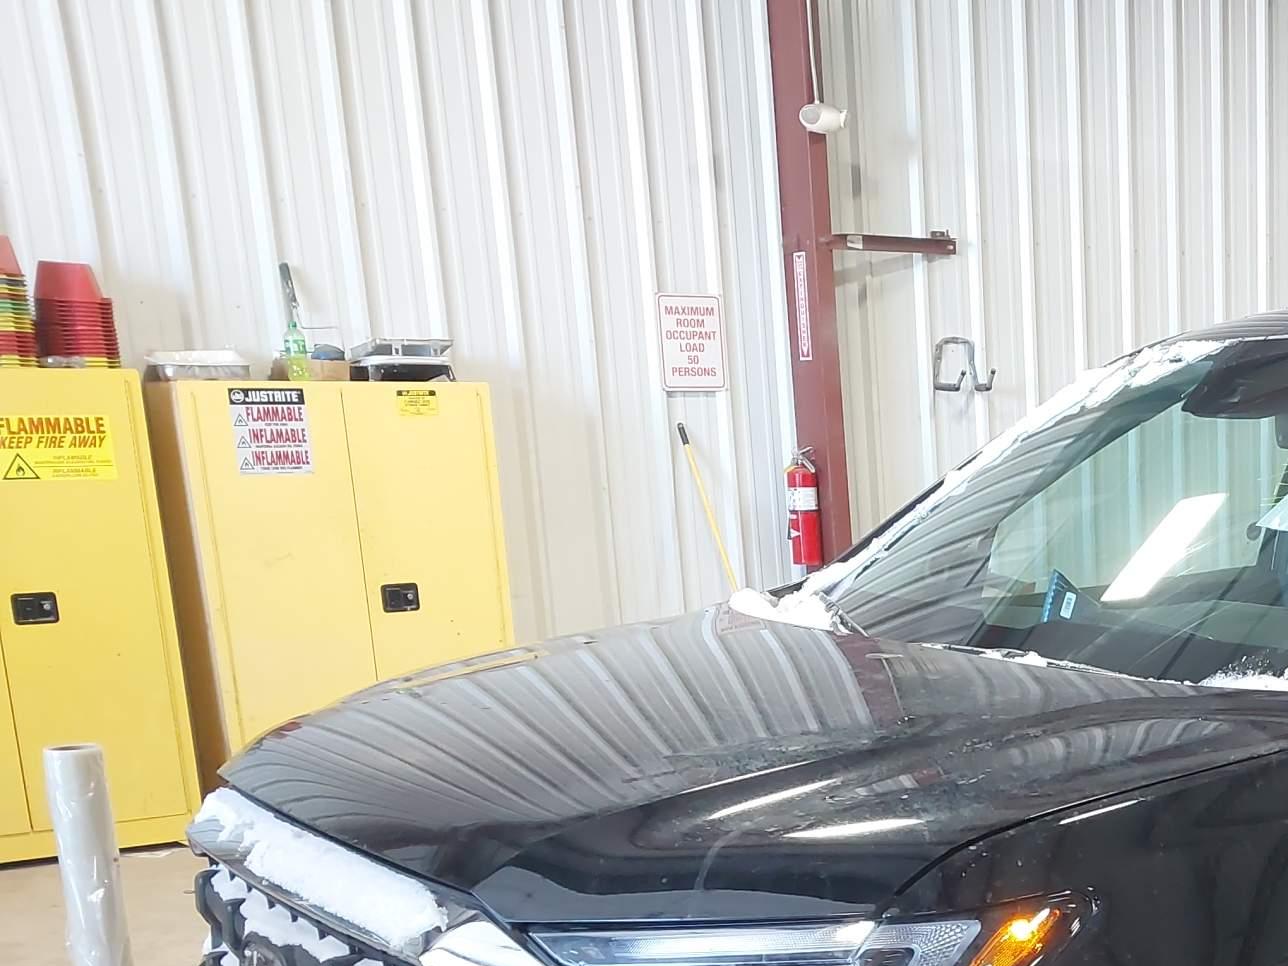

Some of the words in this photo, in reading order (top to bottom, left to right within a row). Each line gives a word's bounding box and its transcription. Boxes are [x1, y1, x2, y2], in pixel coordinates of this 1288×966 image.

[664, 305, 715, 316] MAXIMUM
[676, 318, 705, 328] ROOM
[665, 330, 717, 341] OCCUPANT
[680, 342, 705, 352] LOAD
[687, 355, 700, 365] 50
[672, 367, 717, 377] PERSONS
[245, 390, 299, 402] JUSTRITE
[245, 406, 304, 422] FLAMMABLE
[248, 428, 307, 444] INFLAMABLE
[0, 435, 33, 449] KEEP
[36, 435, 66, 449] FIRE
[68, 435, 107, 449] AWAY
[251, 450, 310, 466] INFLAMMABLE
